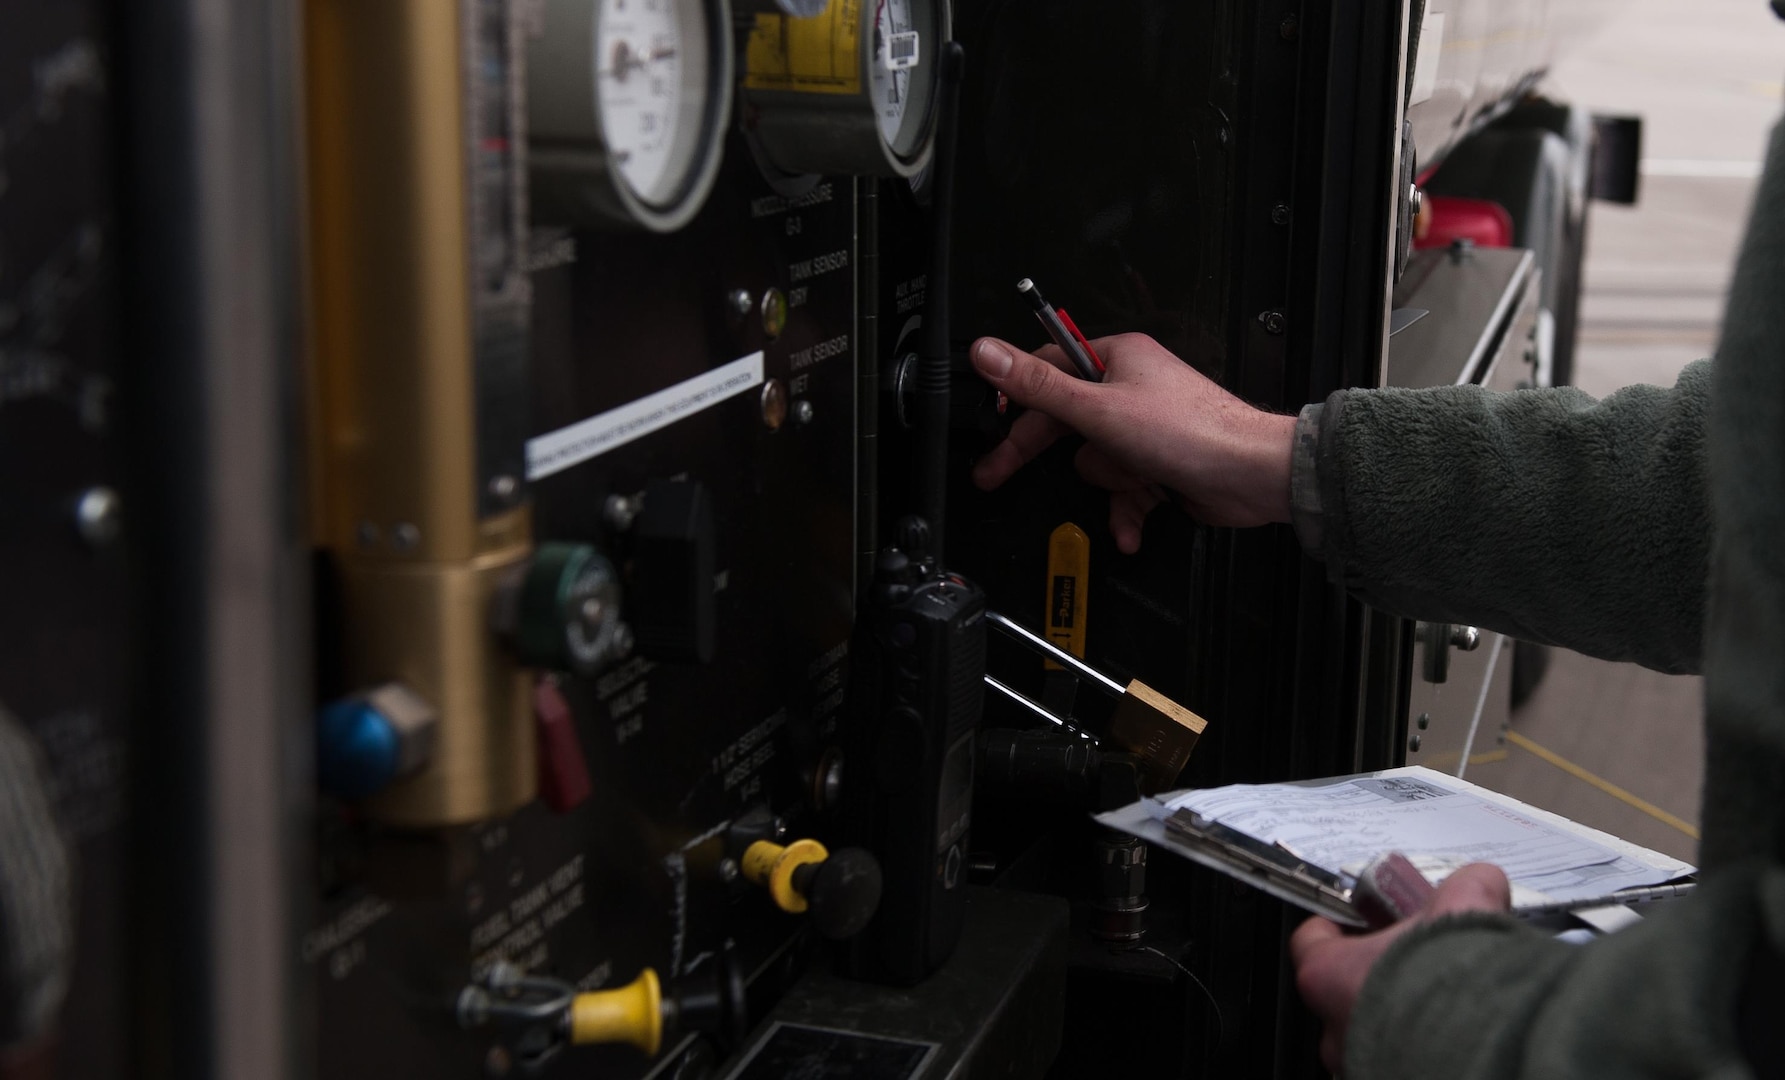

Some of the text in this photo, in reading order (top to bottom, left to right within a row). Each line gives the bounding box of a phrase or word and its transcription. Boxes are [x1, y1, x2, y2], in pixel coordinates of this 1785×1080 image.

[789, 248, 849, 282] TANK SENSOR
[789, 285, 809, 308] DRY
[896, 289, 925, 316] THROTTLE
[789, 333, 849, 372] TANK SENSOR
[789, 372, 810, 397] WET
[1058, 577, 1073, 627] Parker
